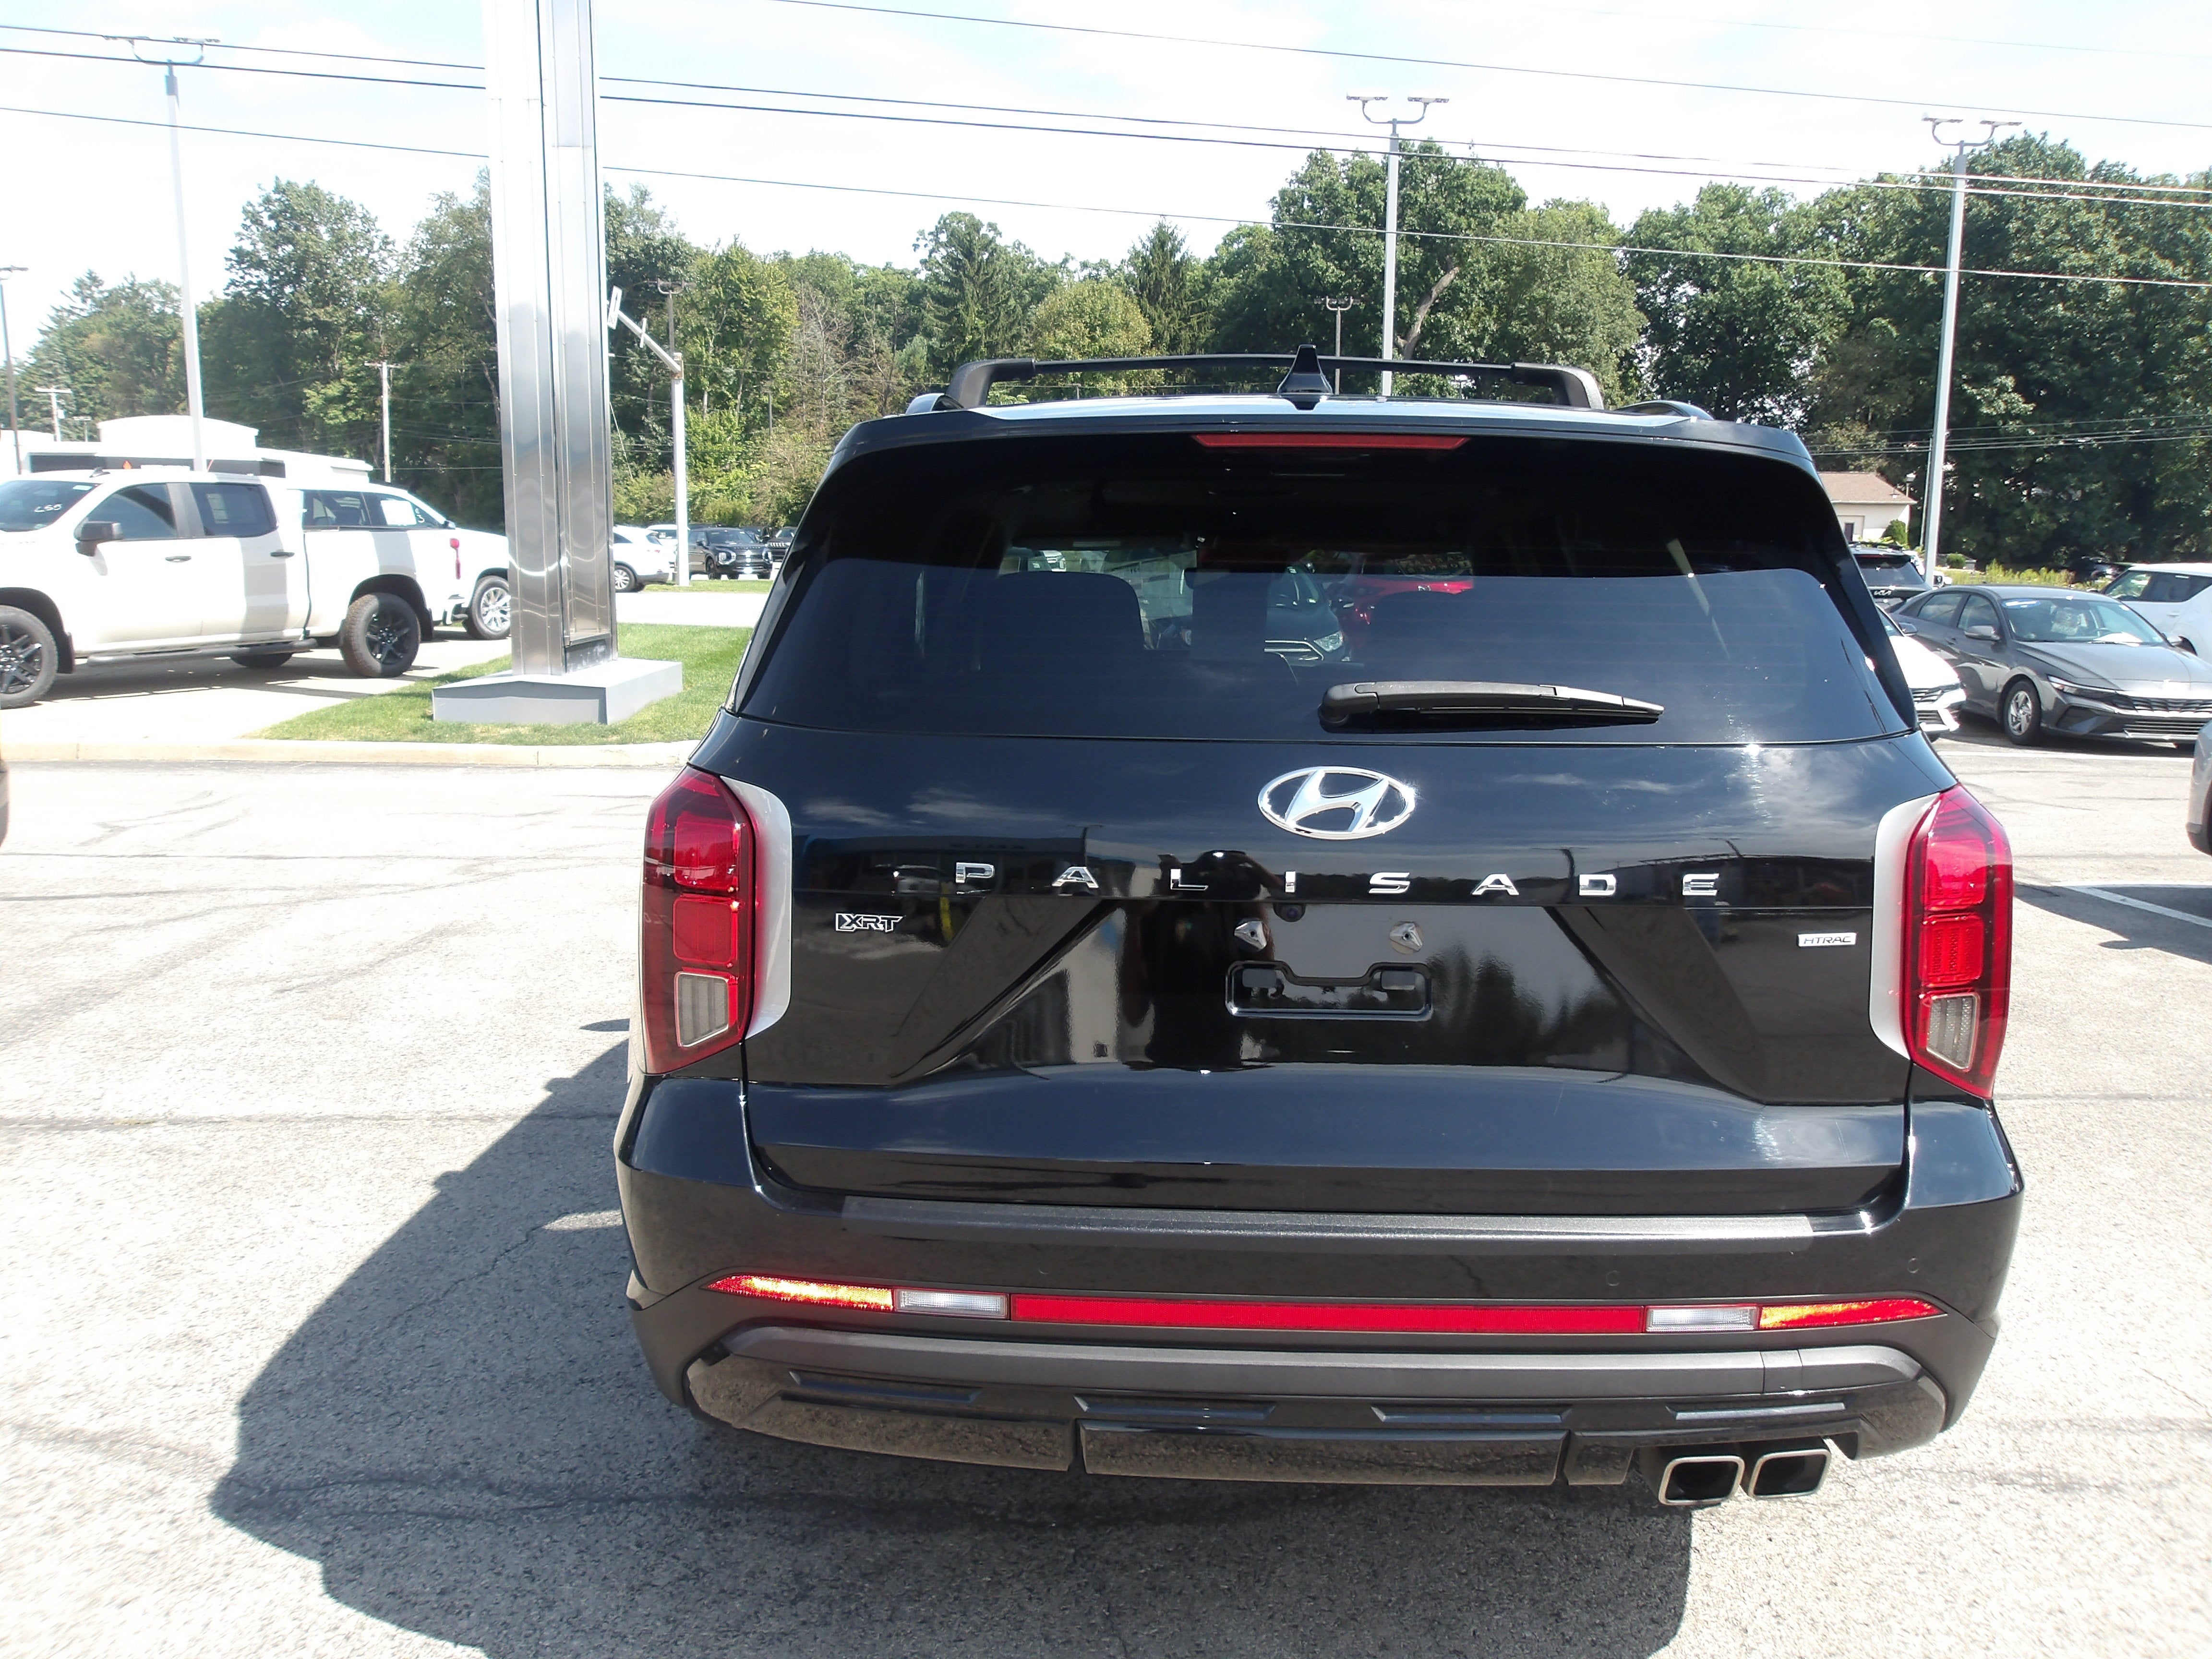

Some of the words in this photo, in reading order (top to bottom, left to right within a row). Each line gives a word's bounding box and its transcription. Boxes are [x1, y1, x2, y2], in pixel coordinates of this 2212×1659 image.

[956, 862, 1720, 896] PALISADE
[835, 913, 903, 933] XRT
[1803, 936, 1852, 945] HTRAC
